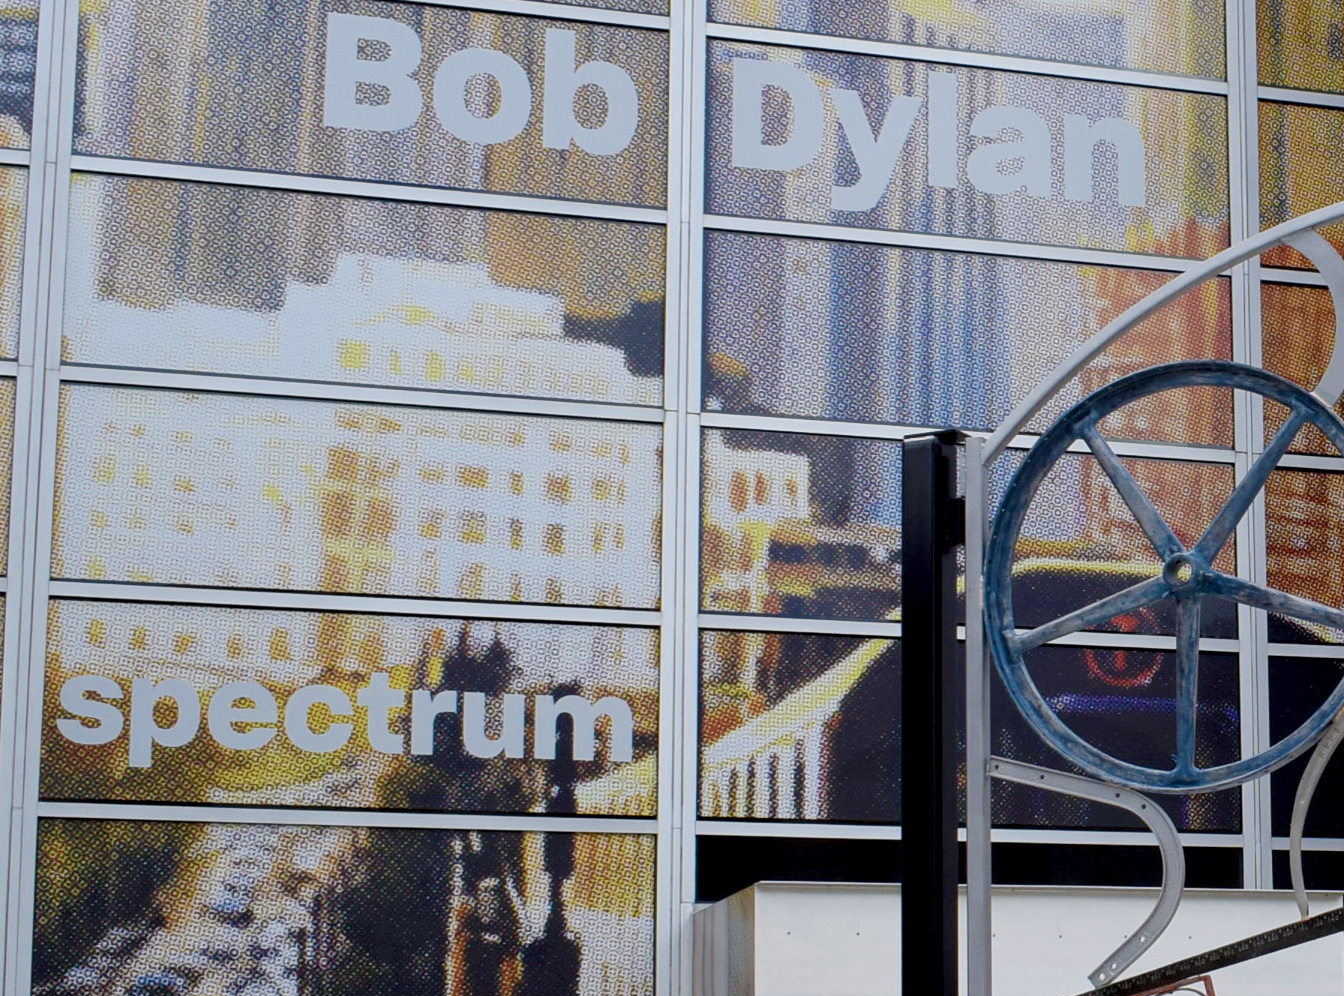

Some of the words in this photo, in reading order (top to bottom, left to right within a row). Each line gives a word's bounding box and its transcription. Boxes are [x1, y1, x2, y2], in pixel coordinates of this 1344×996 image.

[323, 12, 639, 156] Bob
[732, 57, 1146, 212] Dylan
[56, 673, 633, 767] spectrum
